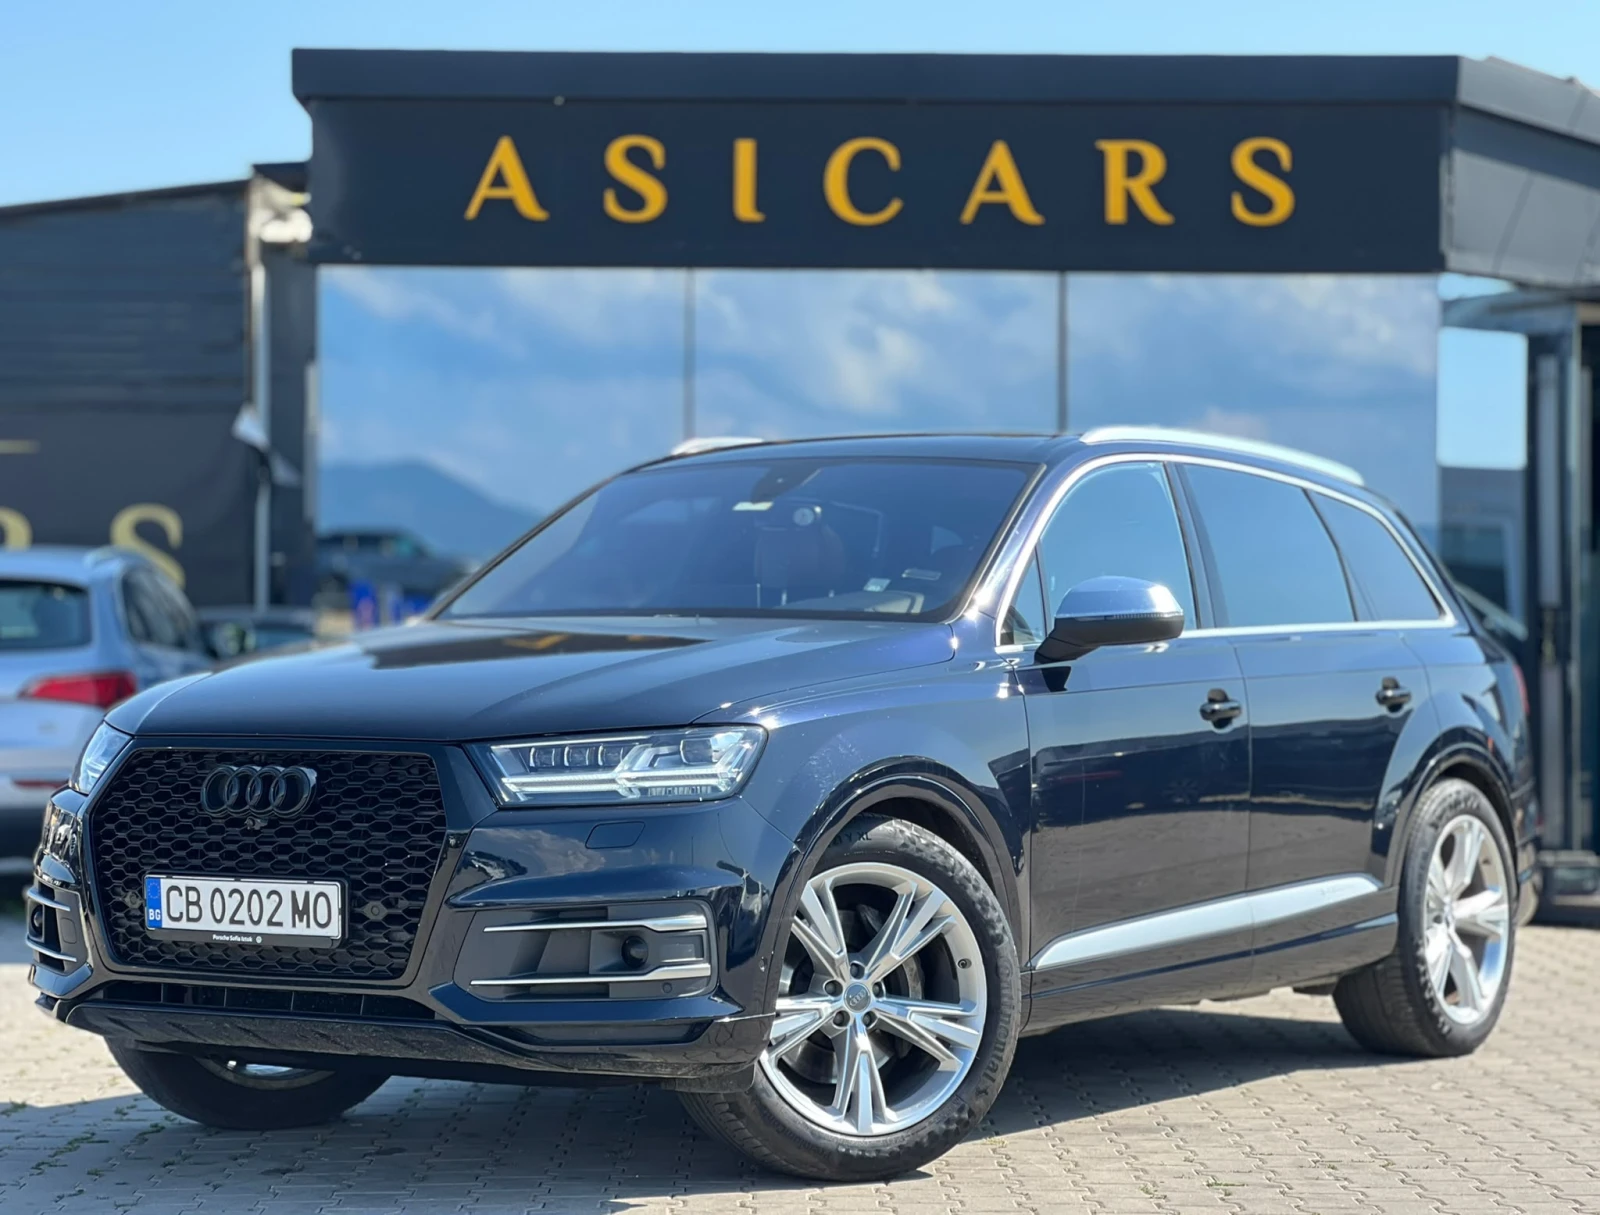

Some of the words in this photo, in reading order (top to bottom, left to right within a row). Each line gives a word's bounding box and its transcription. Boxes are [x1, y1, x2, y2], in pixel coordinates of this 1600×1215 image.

[464, 134, 1297, 228] ASICARS
[149, 909, 161, 921] BG
[166, 885, 203, 923] CB
[210, 887, 284, 927] 0202
[291, 890, 332, 929] MO
[212, 933, 229, 941] Porsche
[230, 934, 241, 942] Sofia
[981, 958, 1015, 1084] Continental
